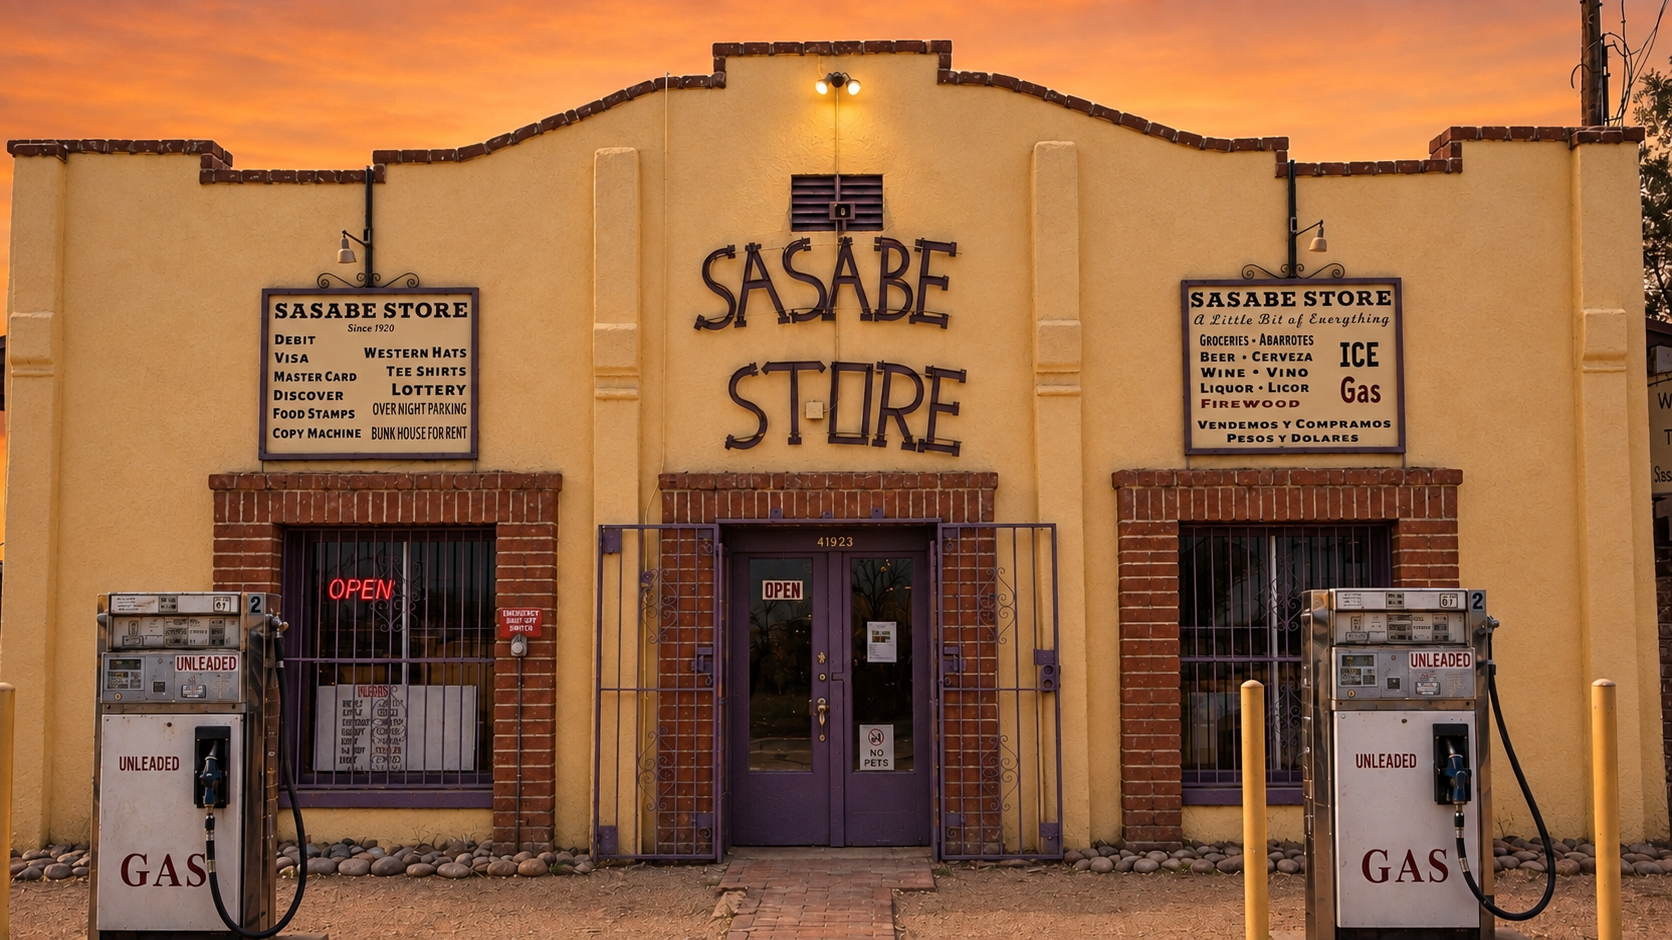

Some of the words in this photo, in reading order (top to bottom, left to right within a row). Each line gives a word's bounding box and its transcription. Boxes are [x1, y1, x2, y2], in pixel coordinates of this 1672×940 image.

[694, 236, 957, 330] SASABE
[1190, 291, 1296, 308] SASABE
[1304, 290, 1391, 306] STORE
[275, 303, 376, 319] SASABE
[383, 302, 468, 318] STORE
[1193, 314, 1204, 325] A
[1210, 314, 1253, 325] Little
[1258, 314, 1283, 325] Bit
[1288, 314, 1304, 328] of
[1309, 313, 1390, 327] Everything
[347, 324, 372, 332] Since
[375, 324, 394, 332] 1920
[275, 334, 316, 345] DEBIT
[1200, 334, 1249, 346] GROCERIES
[1259, 333, 1314, 346] ABARROTES
[275, 352, 309, 363] VISA
[364, 347, 428, 358] WESTERN
[432, 347, 467, 358] HATS
[1200, 352, 1235, 362] BEER
[1252, 351, 1313, 362] CERVEZA
[1340, 342, 1379, 367] ICE
[274, 371, 322, 382] MASTER
[325, 371, 357, 382] CARD
[386, 366, 412, 377] TEE
[416, 366, 467, 377] SHIRTS
[1201, 367, 1246, 378] WINE
[1266, 367, 1309, 377] VINO
[392, 383, 467, 396] LOTTERY
[1200, 383, 1254, 394] LIQUOR
[1268, 382, 1309, 393] LICOR
[1340, 376, 1381, 404] Gas
[274, 390, 344, 401] DISCOVER
[372, 403, 396, 416] OVER
[398, 403, 426, 415] NIGHT
[428, 403, 467, 415] PARKING
[725, 360, 967, 457] STORE
[1201, 399, 1300, 408] FIREWOOD
[273, 408, 305, 419] FOOD
[308, 408, 355, 419] STAMPS
[1198, 420, 1278, 430] VENDEMOS
[1282, 421, 1292, 429] Y
[1295, 419, 1391, 429] COMPRAMOS
[272, 428, 304, 439] COPY
[307, 427, 361, 438] MACHINE
[371, 427, 396, 440] BUNK
[397, 427, 426, 440] HOUSE
[428, 427, 444, 440] FOR
[445, 426, 467, 440] RENT
[1227, 434, 1274, 443] PESOS
[1279, 434, 1287, 443] Y
[1291, 434, 1358, 443] DOLARES
[817, 536, 853, 547] 41923
[329, 578, 395, 600] OPEN
[765, 581, 800, 599] OPEN
[251, 596, 261, 613] 2
[1472, 592, 1483, 609] 2
[176, 656, 236, 671] UNLEADED
[1411, 653, 1471, 668] UNLEADED
[870, 749, 884, 757] NO
[119, 756, 179, 771] UNLEADED
[864, 759, 888, 767] PETS
[1355, 754, 1417, 769] UNLEADED
[121, 853, 207, 887] GAS
[1362, 849, 1449, 883] GAS
